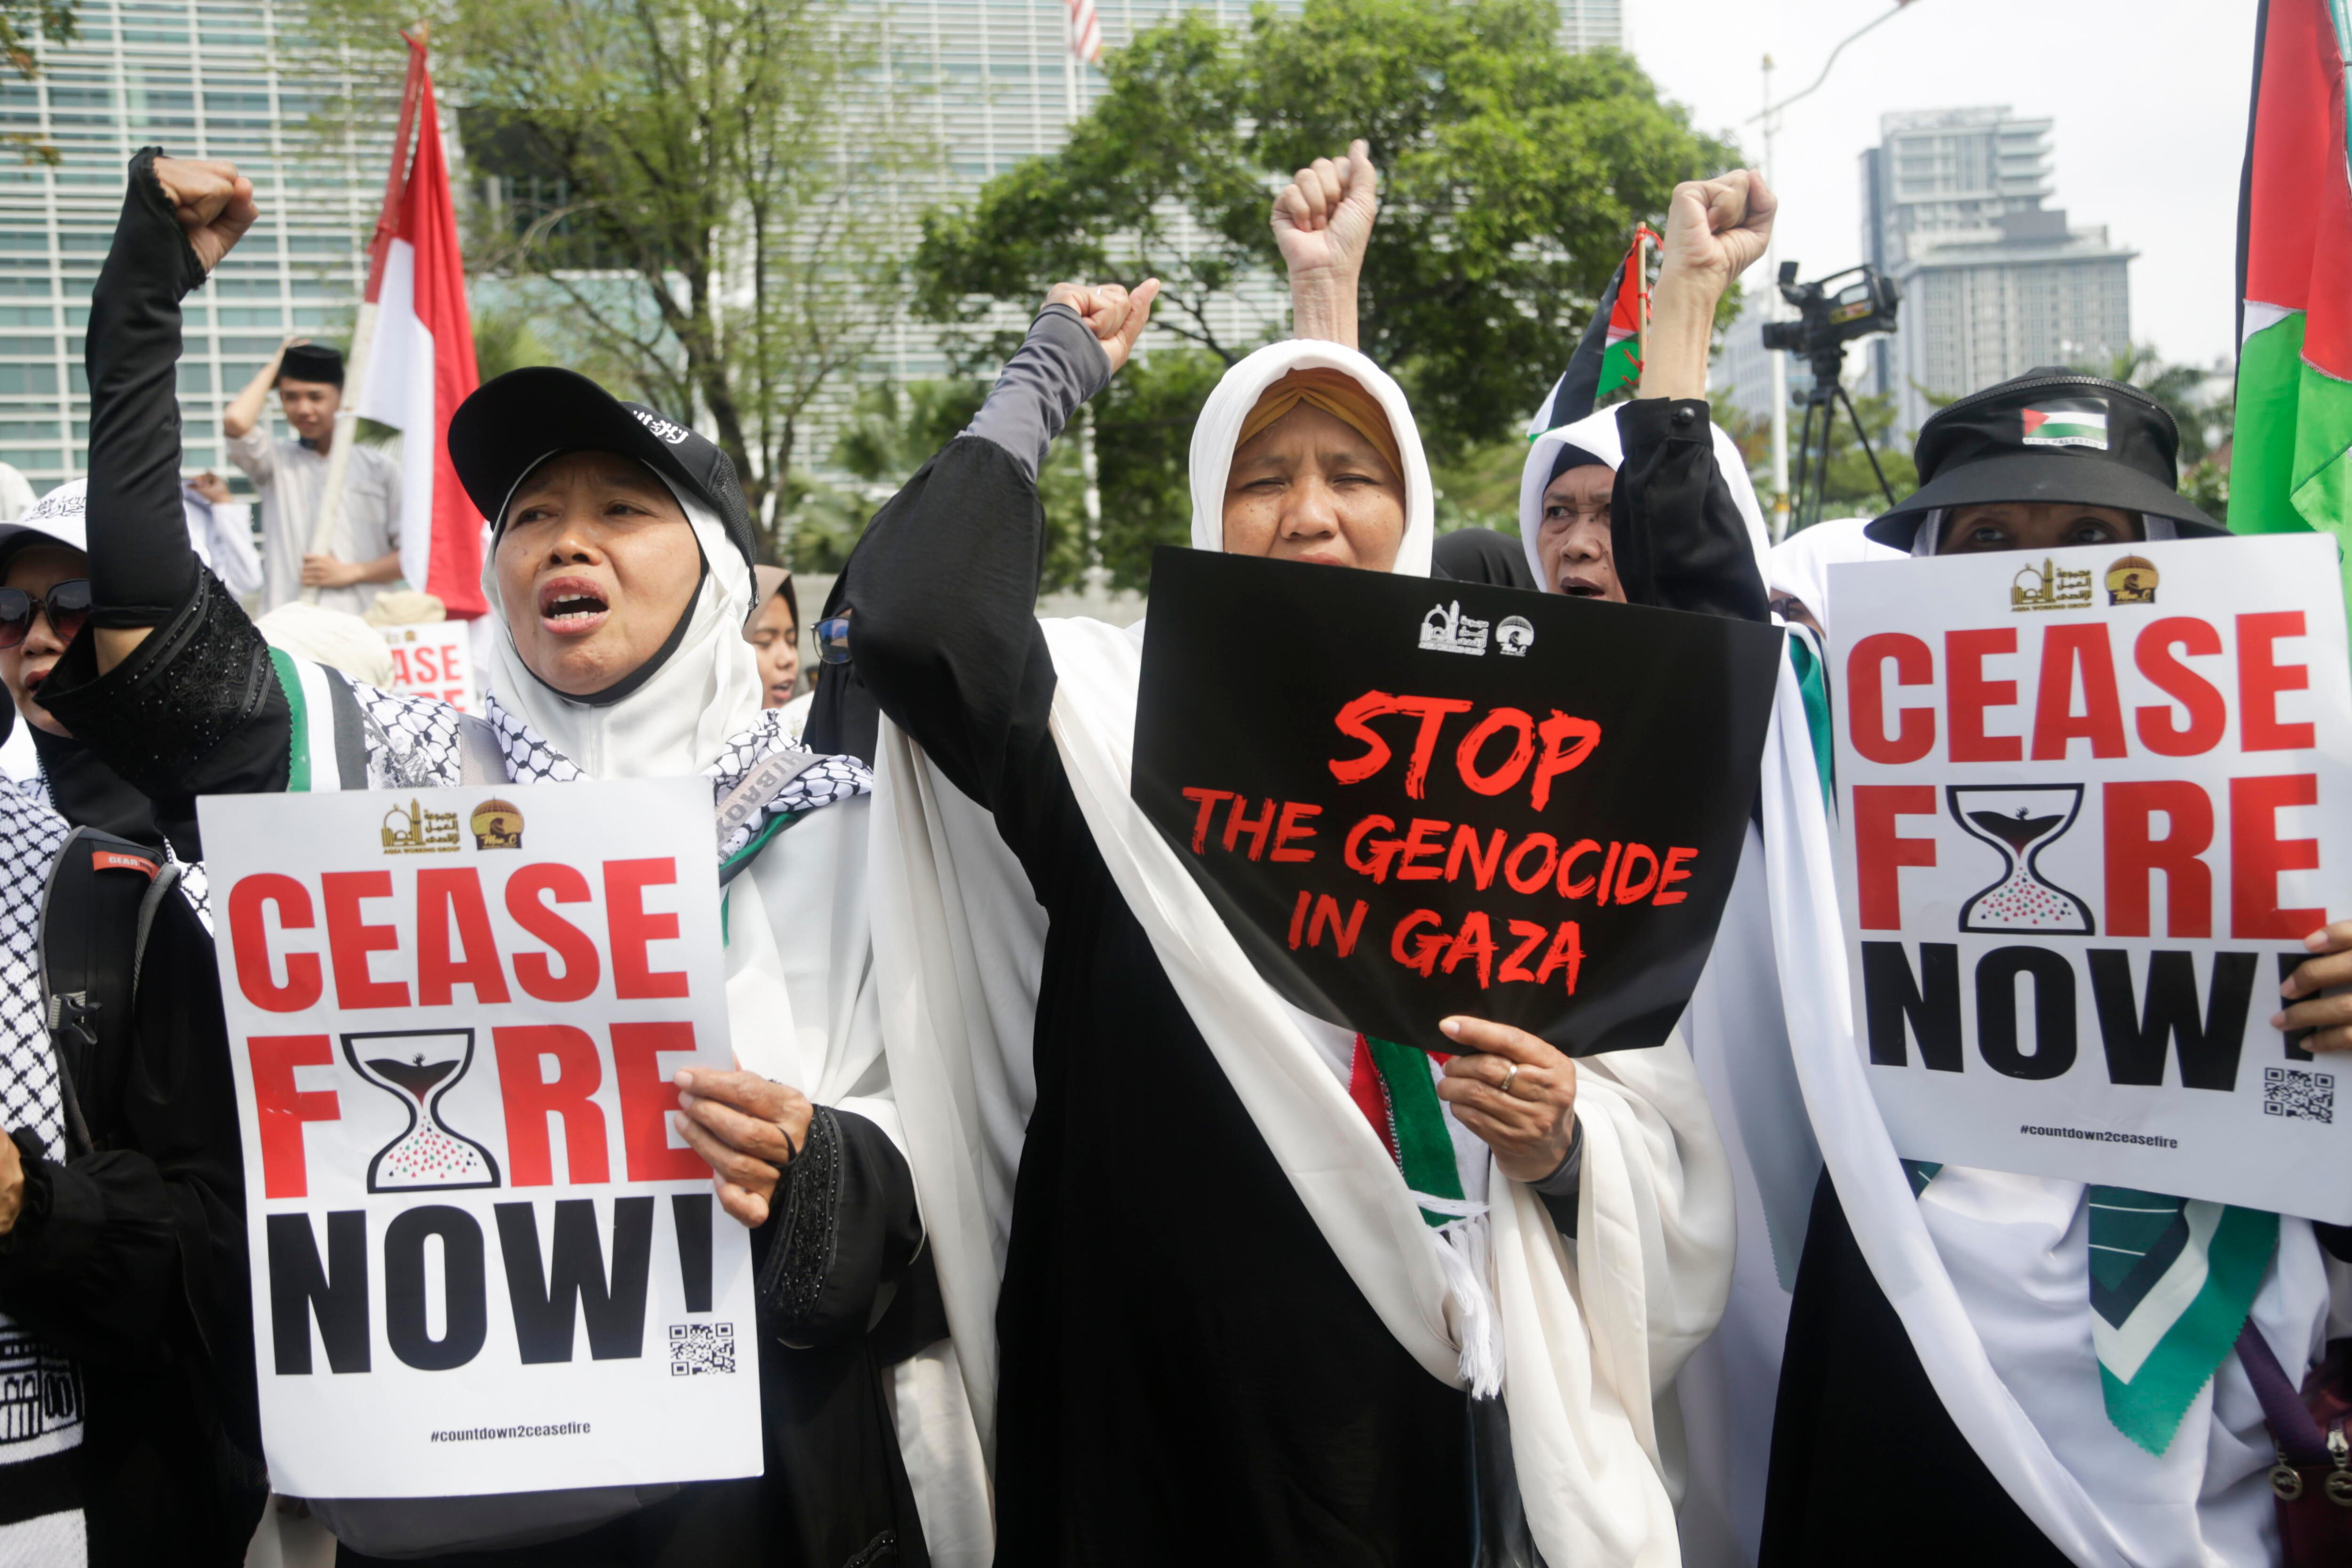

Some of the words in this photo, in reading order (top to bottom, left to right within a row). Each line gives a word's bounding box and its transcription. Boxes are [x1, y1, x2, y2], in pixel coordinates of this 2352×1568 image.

[1849, 612, 2314, 764] CEASE
[1328, 690, 1601, 812] STOP
[108, 856, 138, 866] GEAR
[1183, 787, 1323, 862] THE
[1344, 814, 1699, 907] GENOCIDE
[1854, 774, 2327, 939] FRE
[229, 858, 688, 1012] CEASE
[1289, 891, 1368, 957] IN
[1391, 909, 1586, 995] GAZA
[247, 1022, 714, 1198] FRE
[2020, 1125, 2178, 1149] #countdown2ceasefire
[267, 1194, 712, 1374] NOW!
[430, 1422, 591, 1442] #countdown2ceasefire
